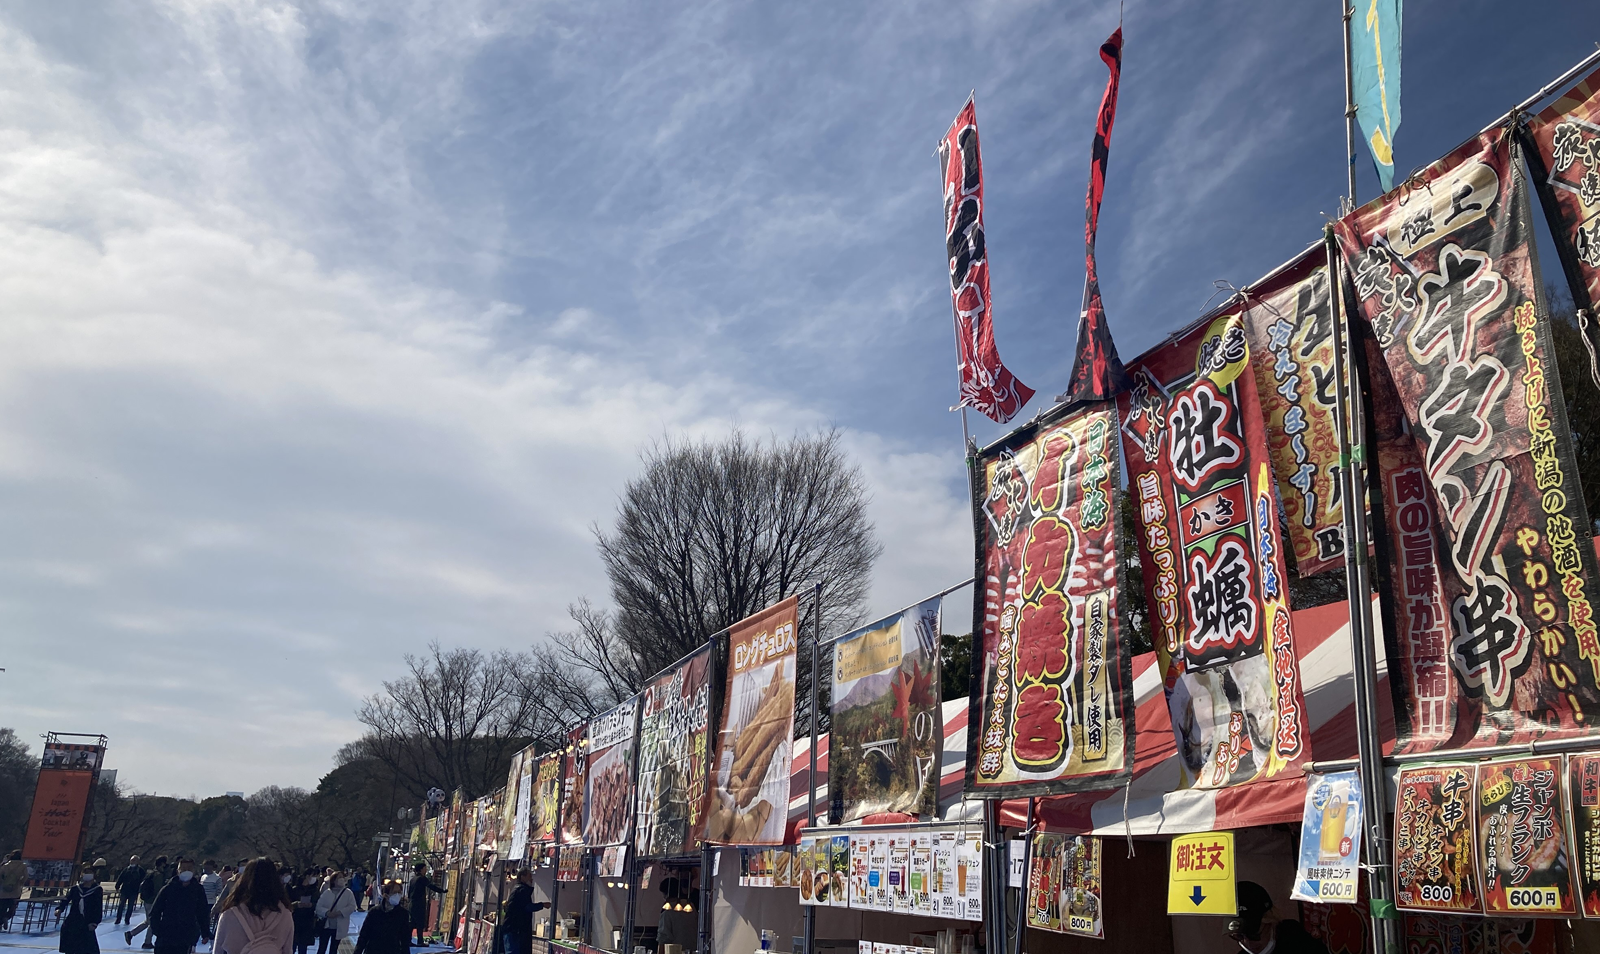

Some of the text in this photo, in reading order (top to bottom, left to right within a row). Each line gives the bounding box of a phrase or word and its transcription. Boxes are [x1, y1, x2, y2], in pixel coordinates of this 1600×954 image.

[1401, 178, 1482, 249] 極上
[1354, 246, 1416, 348] 炭火焼
[1199, 326, 1246, 377] 焼き
[1172, 387, 1237, 483] 牡
[992, 451, 1022, 547] 炭火焼
[1082, 420, 1106, 527] 日本海
[1411, 247, 1528, 700] 牛タン串
[1189, 495, 1234, 536] かき
[1138, 474, 1178, 651] 旨味たっぷり!
[1190, 545, 1254, 643] 蠣
[735, 622, 796, 671] ロングチュロス
[1257, 497, 1299, 753] 日本海 産地直送
[1517, 527, 1585, 721] やわらかい!
[1087, 597, 1104, 752] 自家製ダレ使用
[1443, 770, 1468, 829] 牛串
[1533, 769, 1554, 840] ジャンボ
[1585, 761, 1597, 793] 和牛
[43, 818, 70, 826] Cocktail
[43, 827, 63, 837] Fair
[44, 808, 71, 817] Hot
[1399, 786, 1416, 850] 牛ハラミ串
[1413, 799, 1431, 866] 牛カルビ串
[1510, 784, 1532, 885] 生フランク
[1012, 858, 1024, 875] 17
[1176, 842, 1225, 872] 御注文
[1307, 867, 1351, 880] 風味爽快ニシテ
[1340, 841, 1350, 854] 新
[1429, 825, 1445, 881] 牛タン串
[1422, 886, 1452, 901] 800
